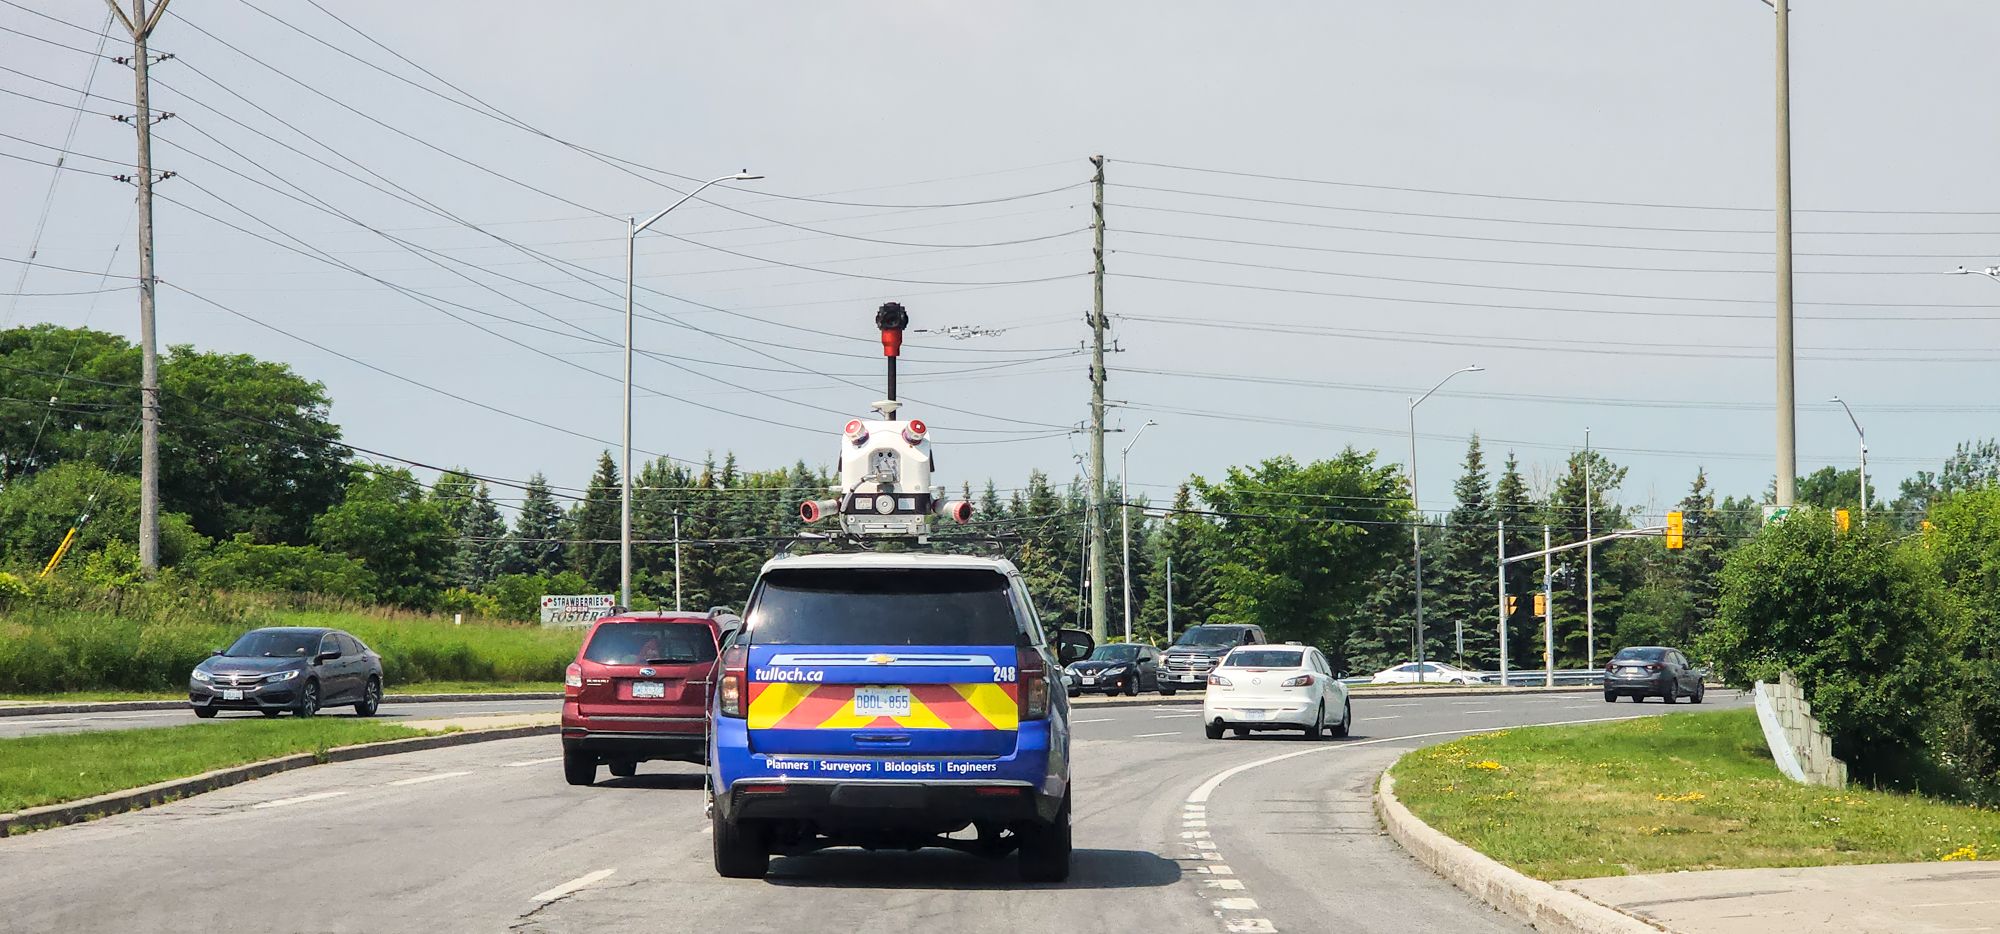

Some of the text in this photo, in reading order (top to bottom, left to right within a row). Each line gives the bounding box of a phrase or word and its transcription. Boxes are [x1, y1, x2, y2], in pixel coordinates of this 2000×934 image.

[553, 597, 604, 606] STRAWBERRIES
[755, 667, 824, 682] tulloch.ca
[993, 666, 1016, 682] 248
[888, 695, 908, 709] 855
[766, 759, 997, 774] Planners Surveyors Biologists Engineers
